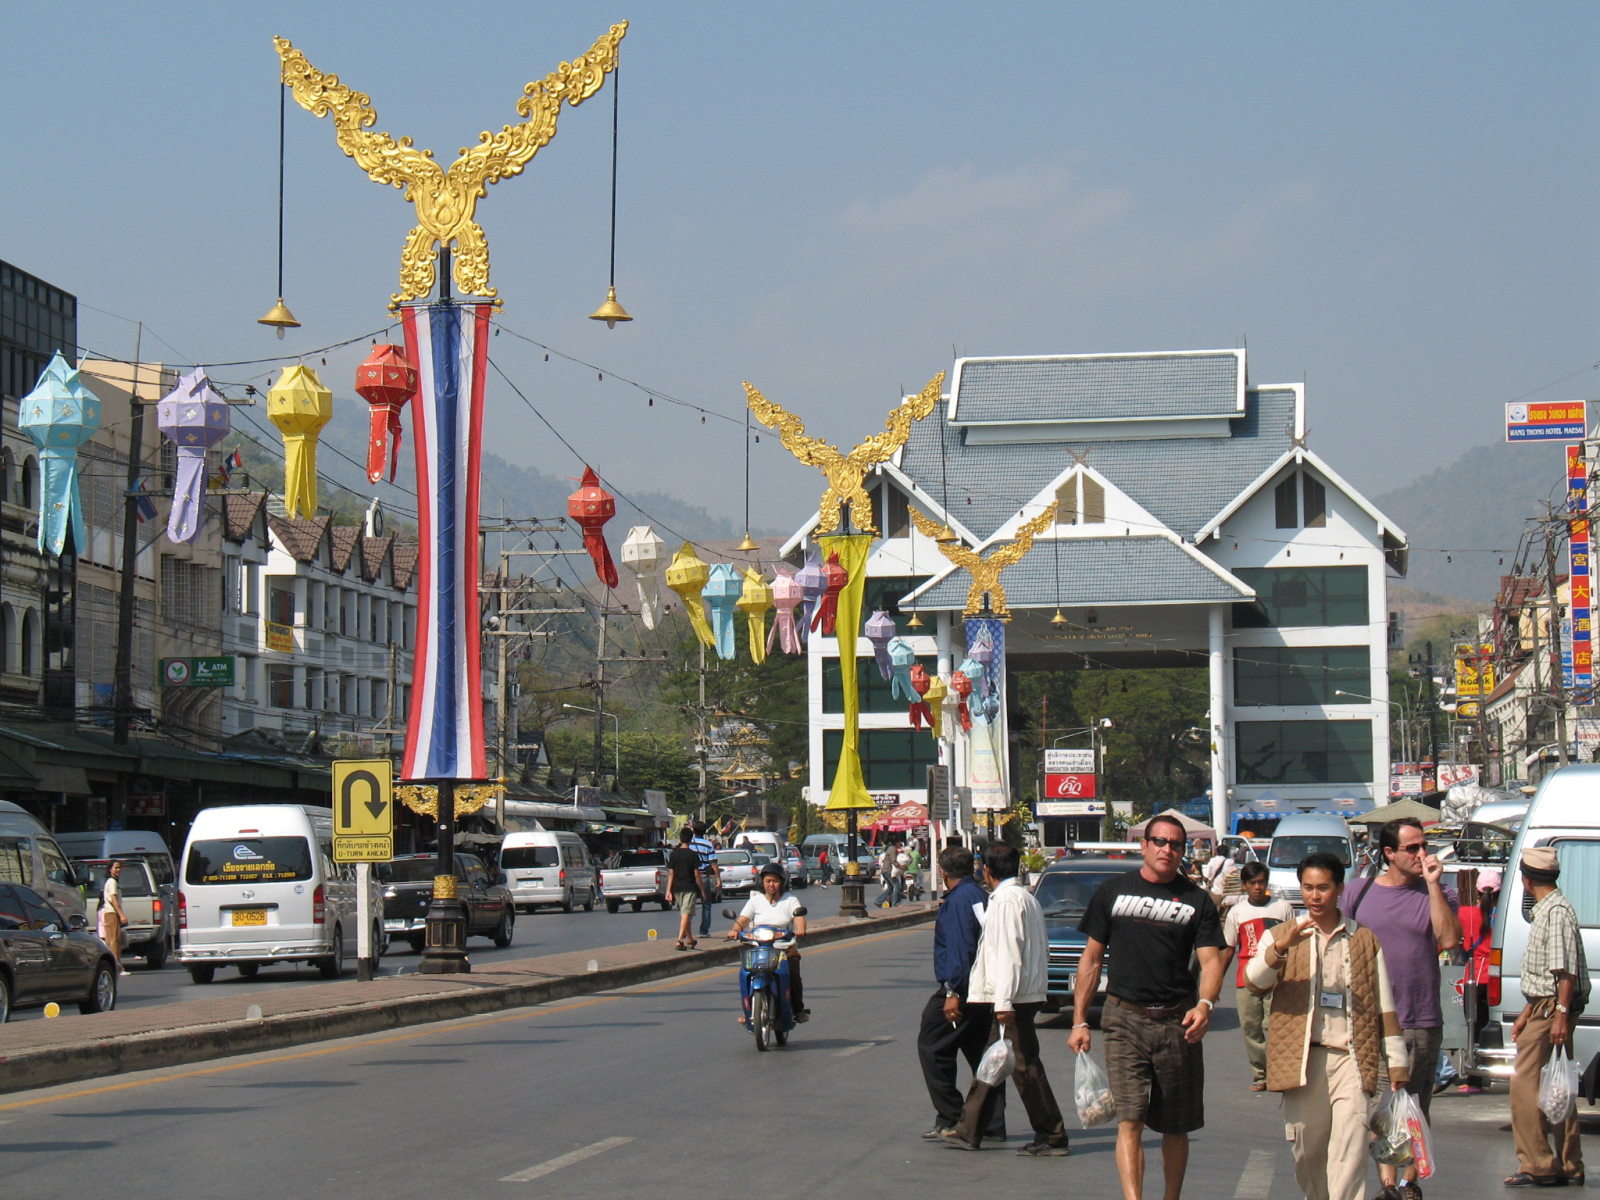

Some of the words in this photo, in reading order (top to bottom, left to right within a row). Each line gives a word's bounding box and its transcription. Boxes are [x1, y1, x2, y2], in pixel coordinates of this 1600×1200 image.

[1526, 428, 1545, 436] THONG
[212, 663, 227, 671] ATM
[338, 850, 364, 858] U-TURN
[1111, 894, 1197, 926] HIGHER
